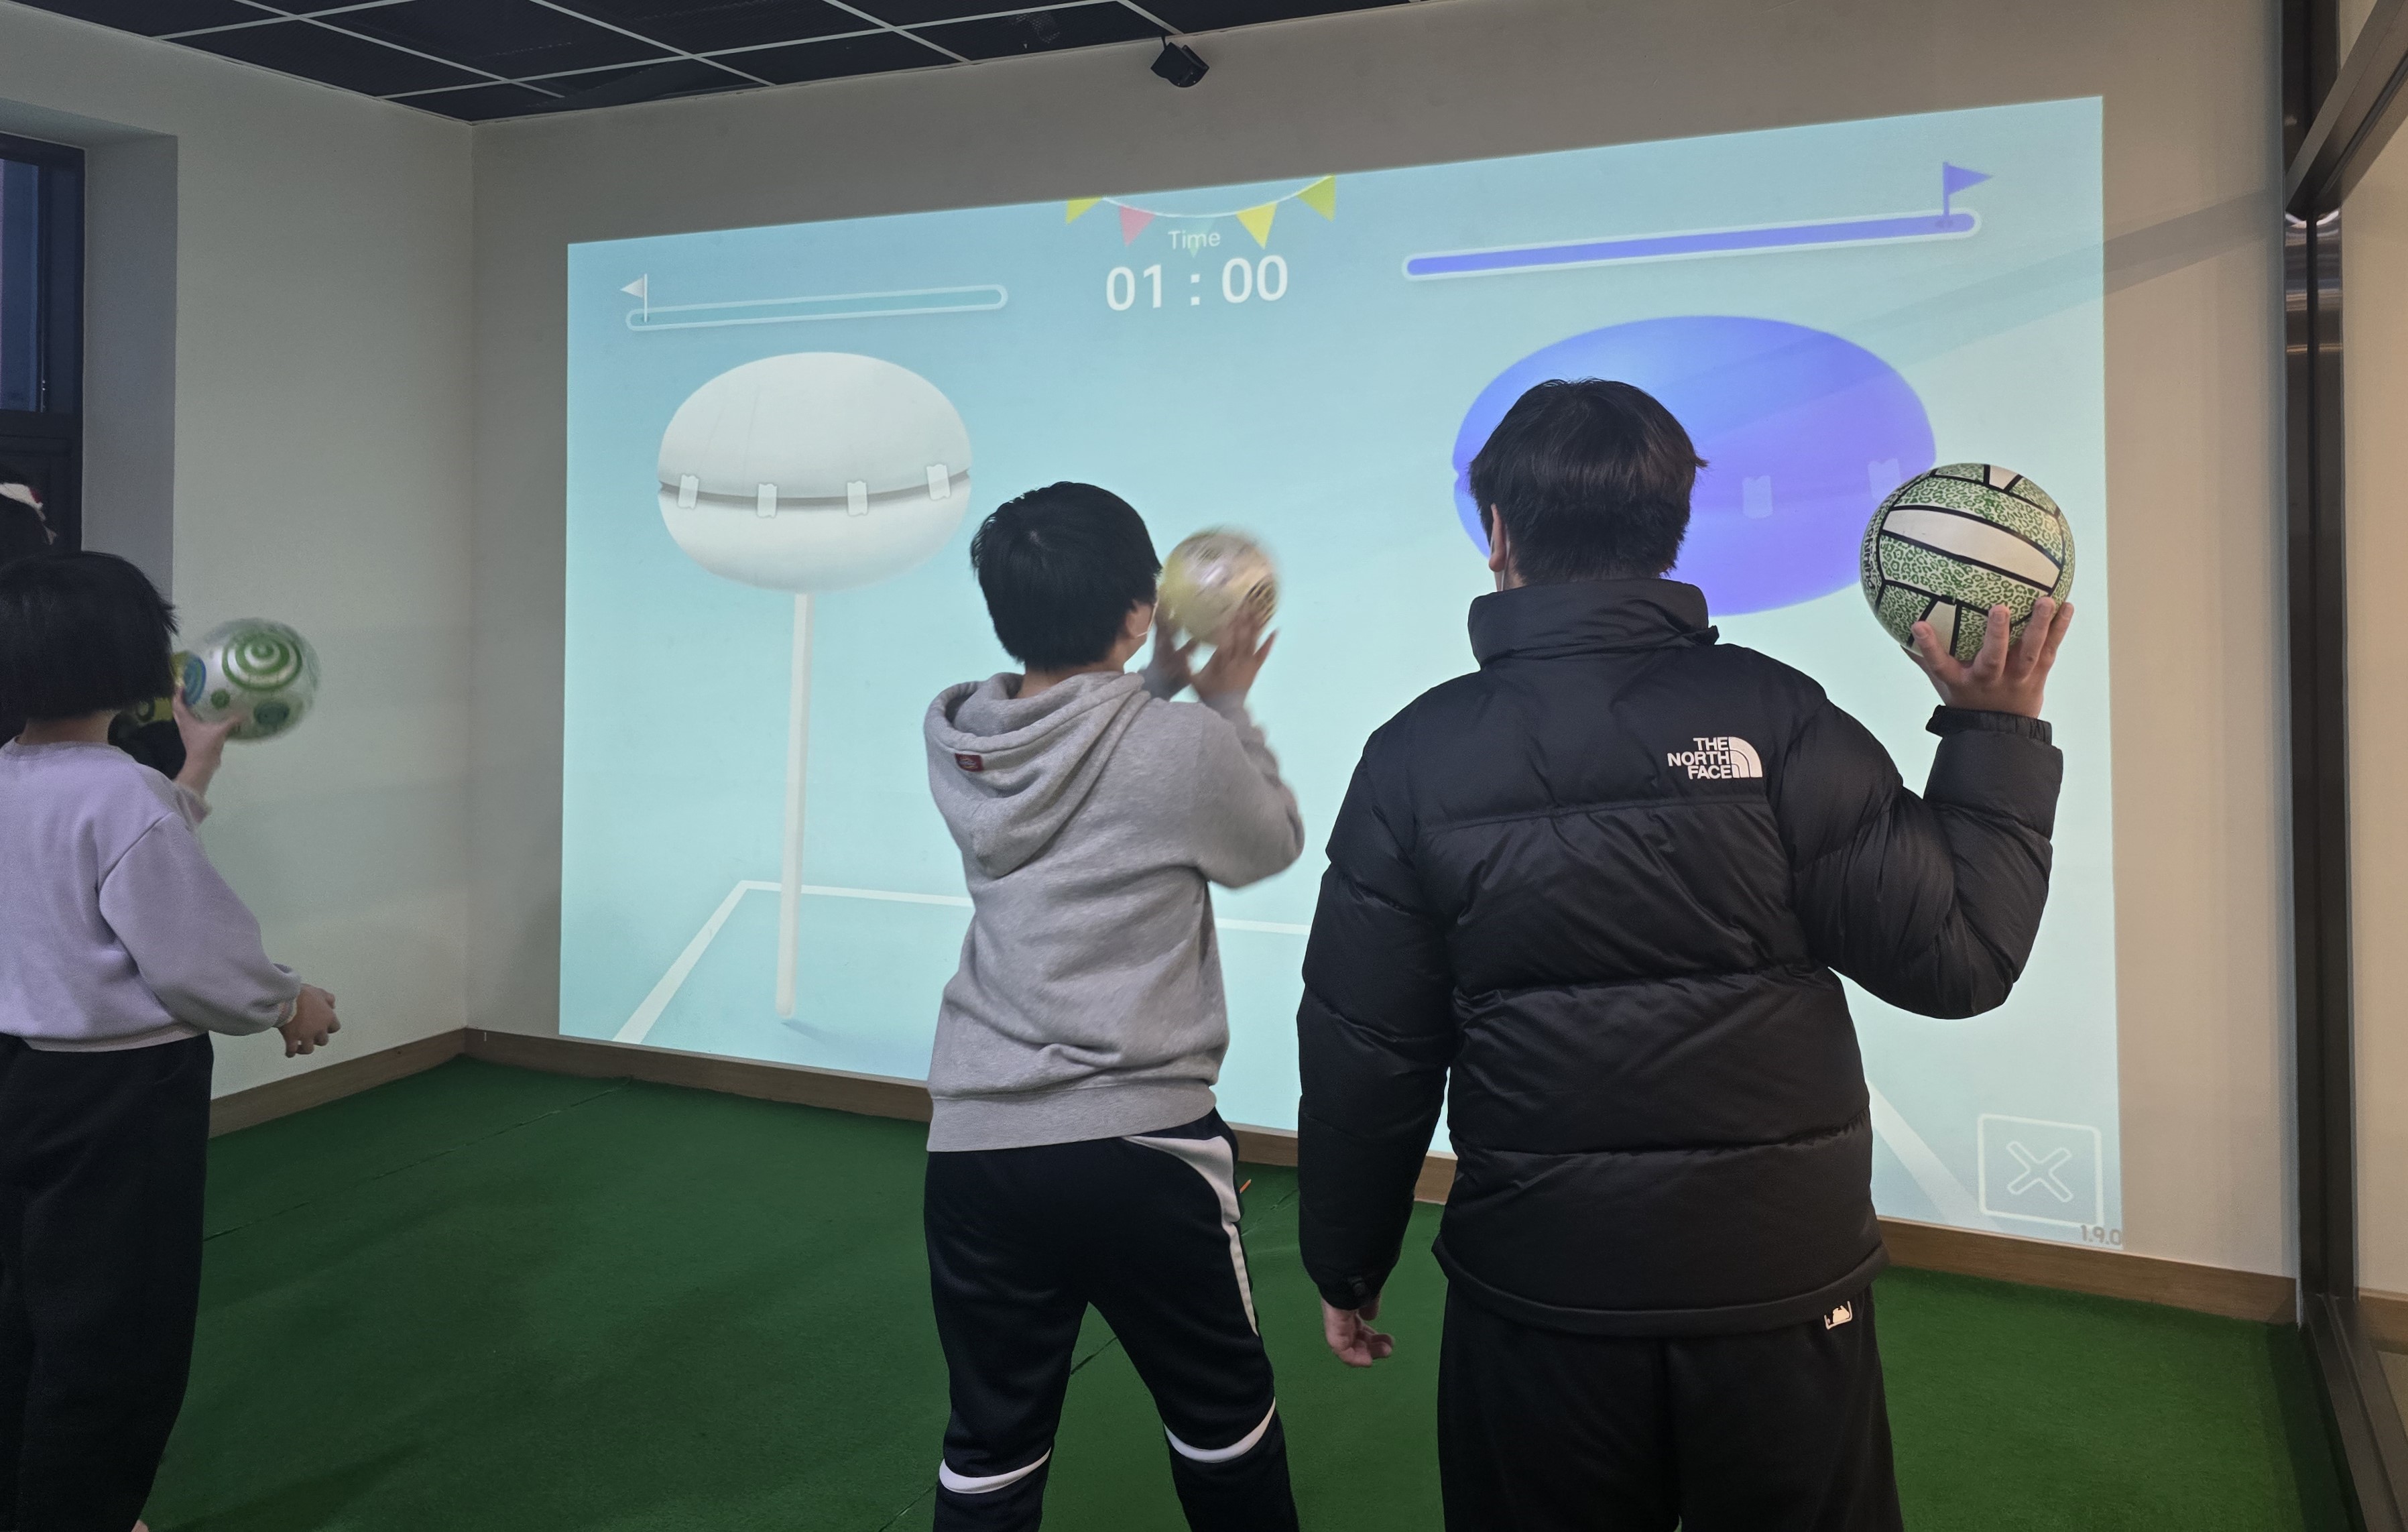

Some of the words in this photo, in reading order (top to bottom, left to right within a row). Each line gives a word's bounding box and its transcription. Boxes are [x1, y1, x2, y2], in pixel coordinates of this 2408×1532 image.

[1168, 229, 1221, 250] Time
[1105, 264, 1162, 311] 01
[1221, 254, 1288, 304] 00
[1693, 737, 1729, 751] THE
[1667, 751, 1730, 767] NORTH
[1687, 765, 1732, 780] FACE
[2080, 1225, 2122, 1246] 1.9.0
